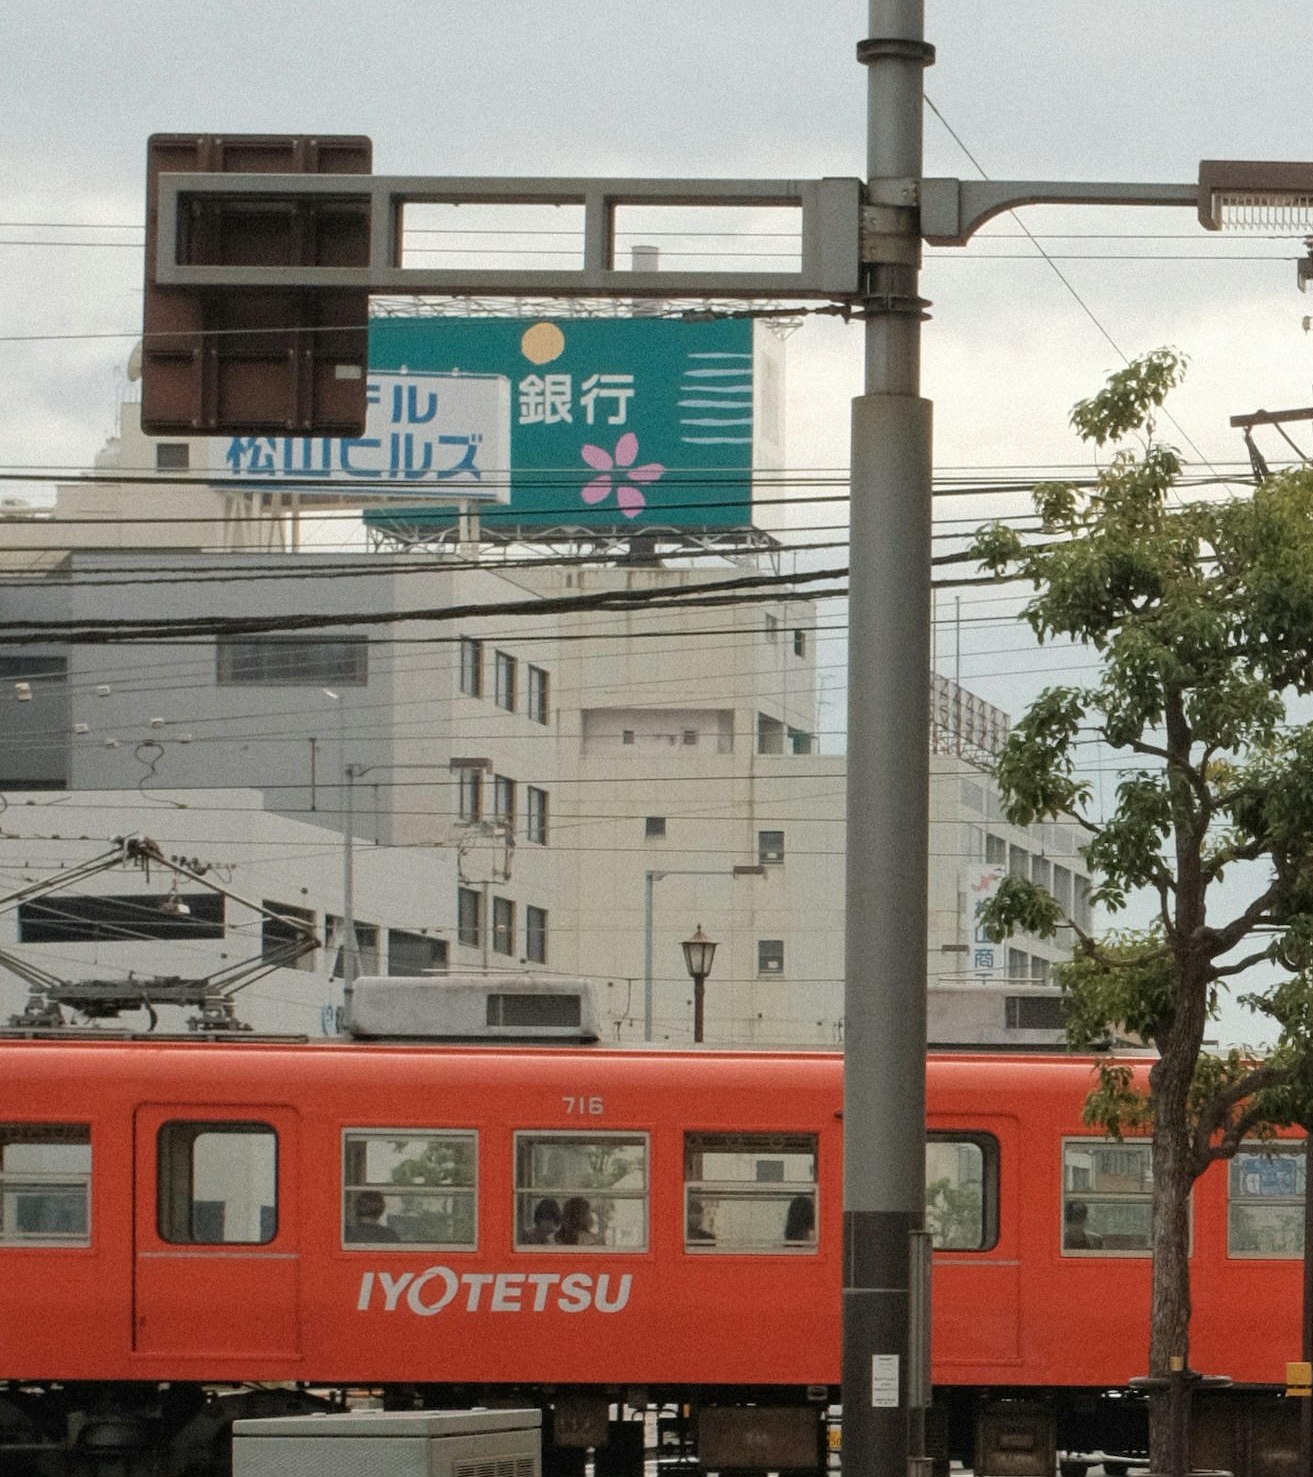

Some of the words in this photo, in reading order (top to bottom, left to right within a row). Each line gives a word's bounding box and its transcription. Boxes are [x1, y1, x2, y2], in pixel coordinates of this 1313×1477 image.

[518, 373, 636, 425] 銀行
[562, 1096, 604, 1115] 716
[356, 1265, 633, 1316] IYOTETSU
